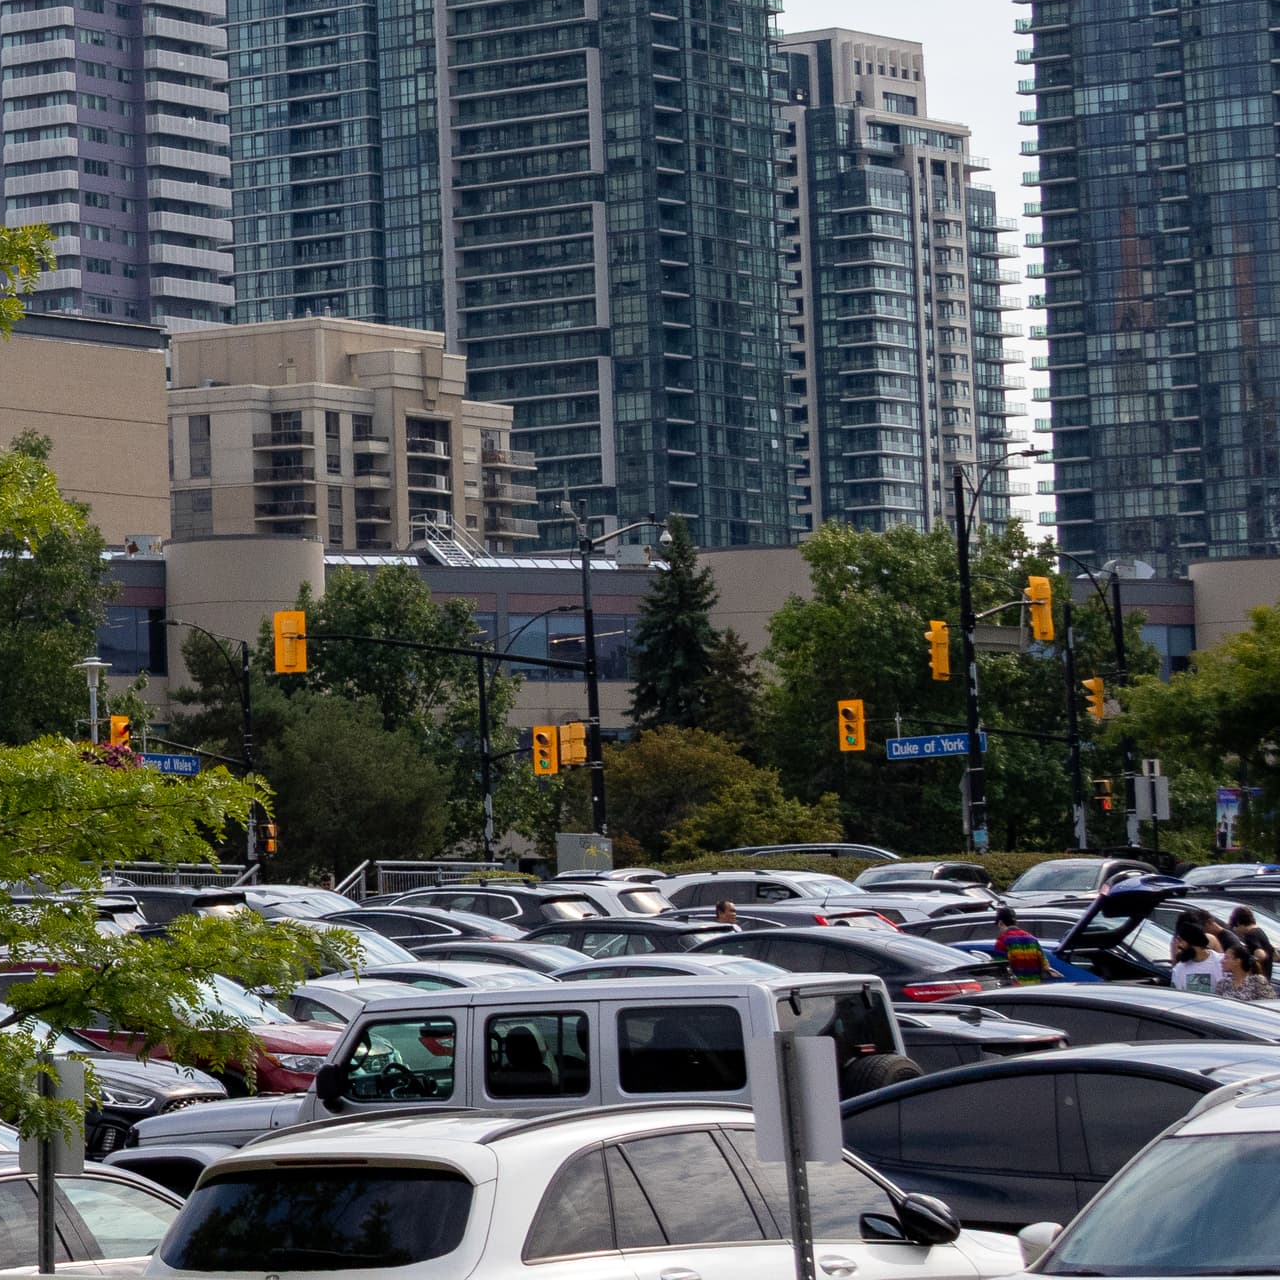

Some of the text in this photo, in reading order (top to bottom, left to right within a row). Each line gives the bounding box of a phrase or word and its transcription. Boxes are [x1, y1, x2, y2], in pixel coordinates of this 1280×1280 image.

[892, 739, 965, 755] Duke of York
[164, 758, 171, 770] of
[173, 758, 192, 771] Wales
